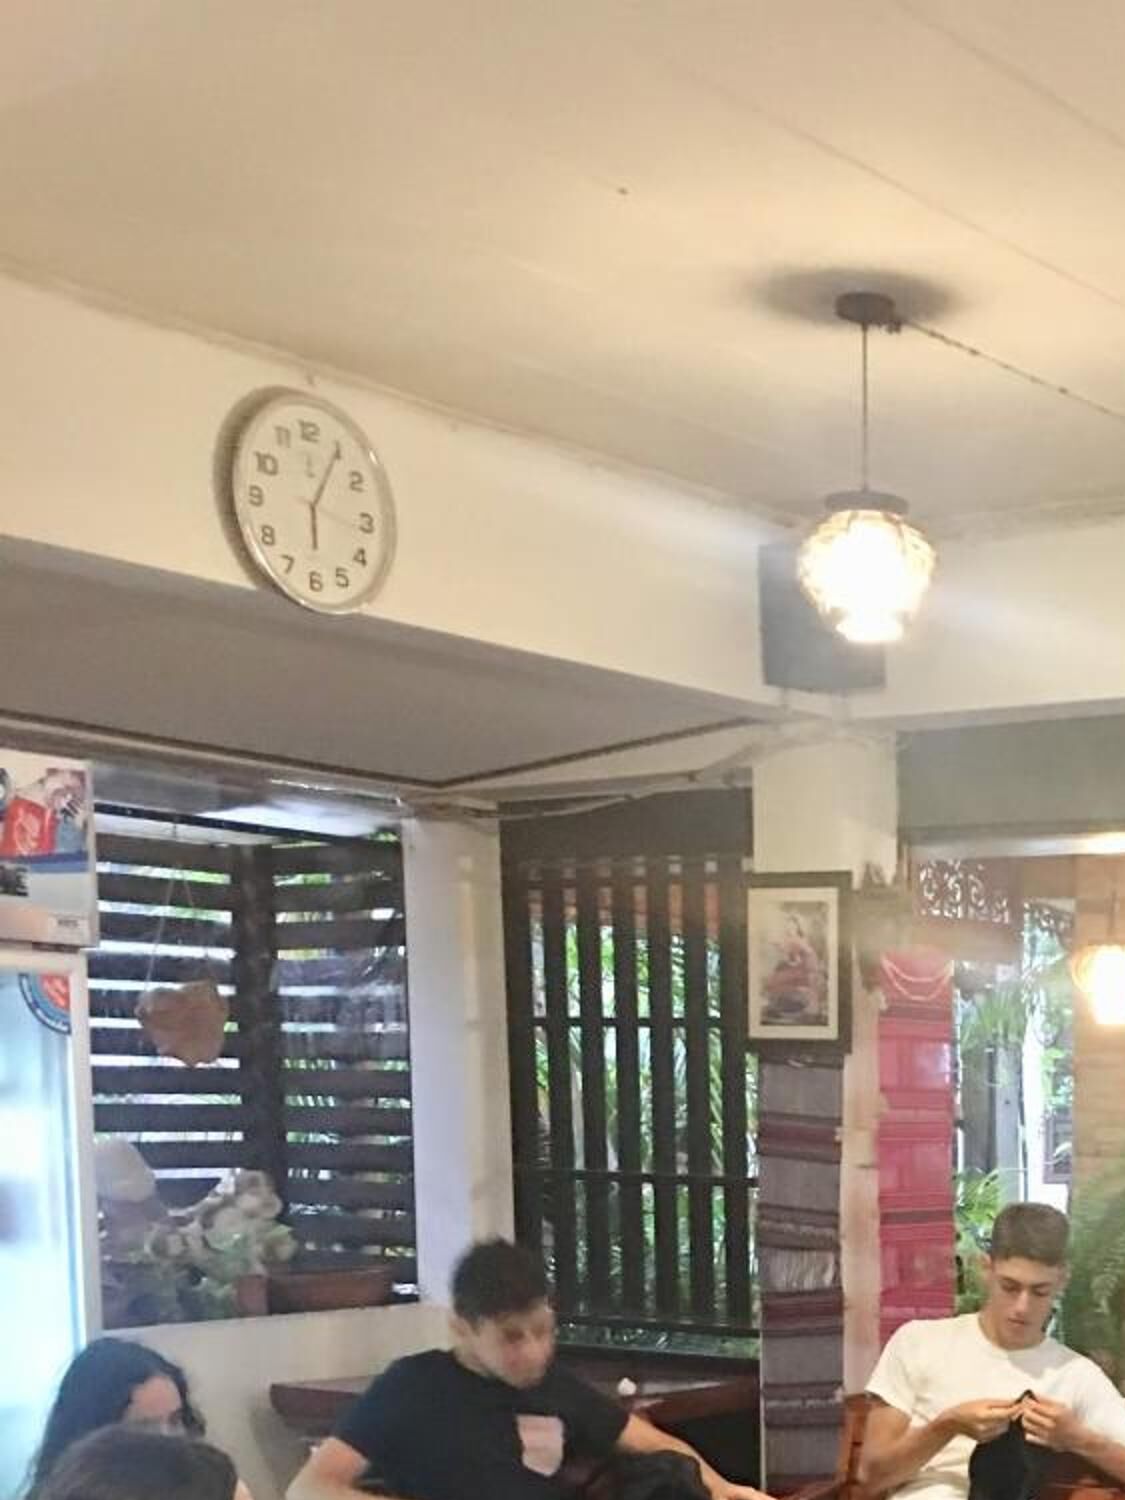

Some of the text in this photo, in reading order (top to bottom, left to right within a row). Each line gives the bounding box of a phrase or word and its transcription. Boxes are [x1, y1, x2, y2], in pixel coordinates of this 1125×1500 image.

[275, 426, 291, 448] 11
[298, 420, 321, 443] 12
[255, 452, 279, 476] 10
[350, 472, 364, 492] 2
[249, 486, 264, 506] 9
[359, 513, 375, 534] 3
[261, 525, 276, 546] 8
[281, 554, 295, 574] 7
[353, 548, 367, 567] 4
[309, 571, 323, 592] 6
[335, 568, 350, 588] 5
